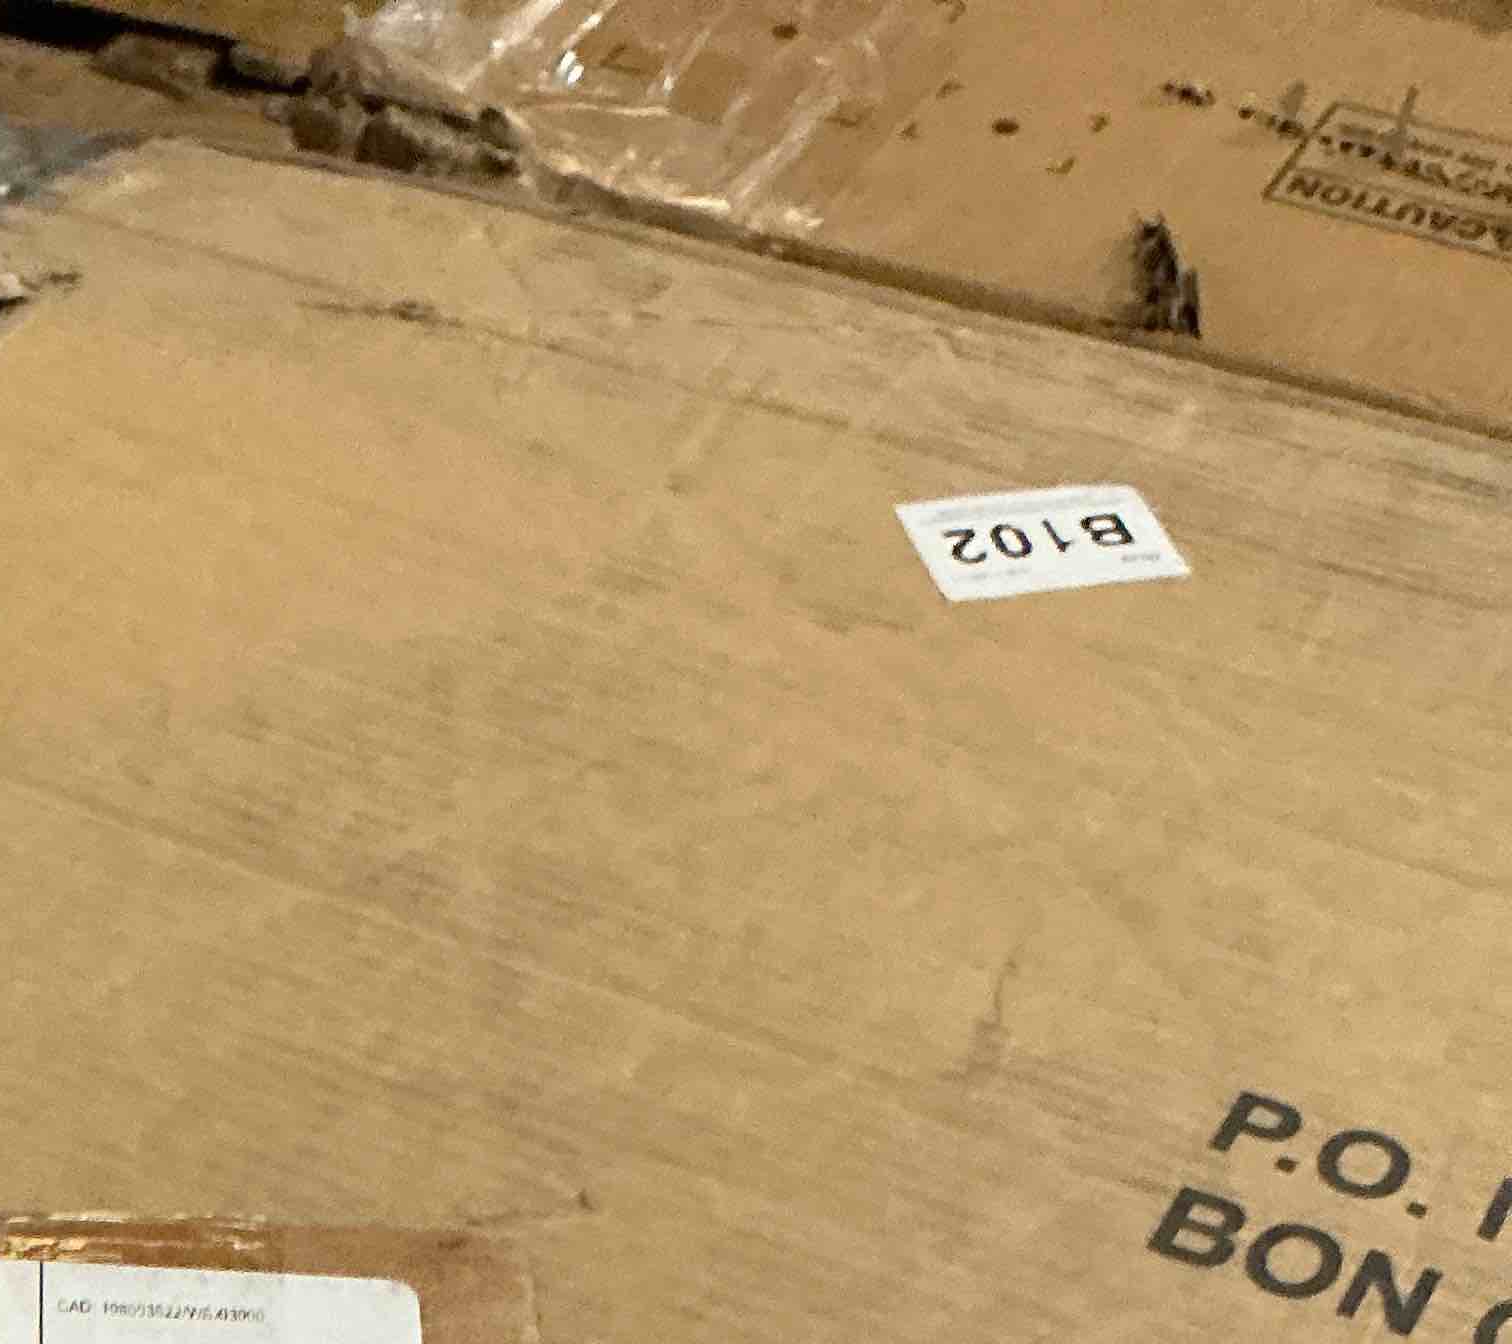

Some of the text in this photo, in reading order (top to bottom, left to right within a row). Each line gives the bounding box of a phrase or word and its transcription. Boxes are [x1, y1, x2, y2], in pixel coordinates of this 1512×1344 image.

[1287, 173, 1488, 241] CAUTION
[941, 511, 1136, 564] B102
[1209, 1091, 1428, 1219] P.O.
[1145, 1186, 1443, 1338] BON
